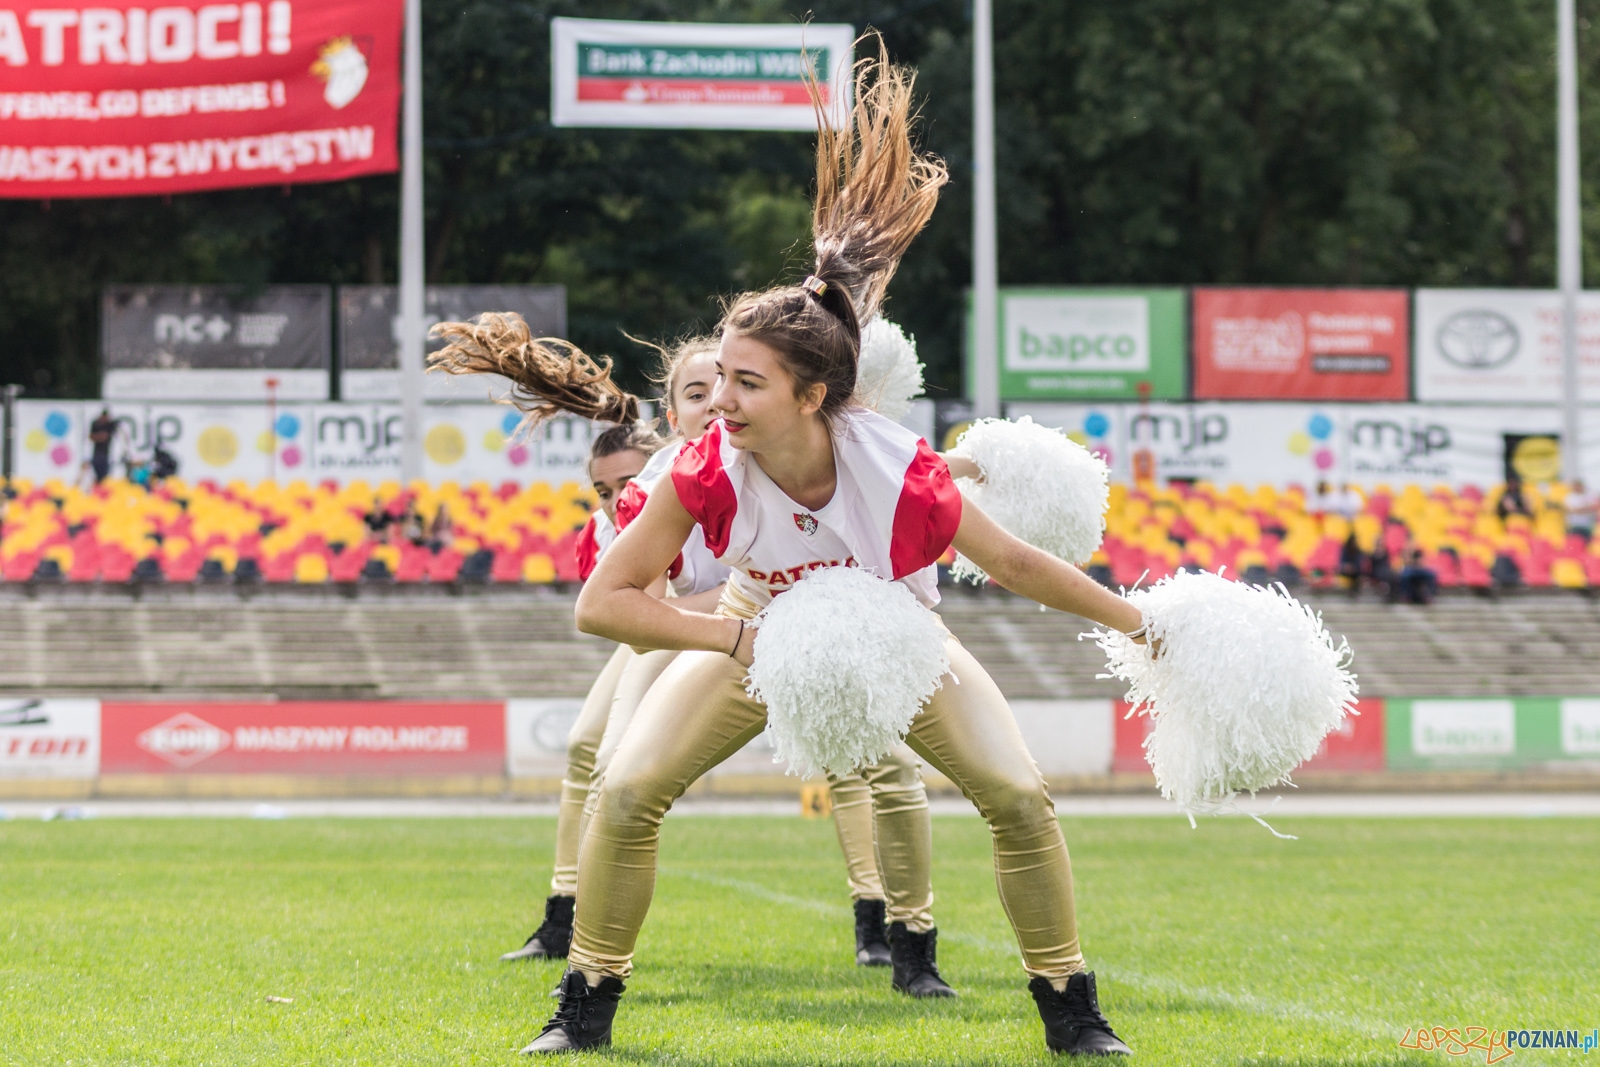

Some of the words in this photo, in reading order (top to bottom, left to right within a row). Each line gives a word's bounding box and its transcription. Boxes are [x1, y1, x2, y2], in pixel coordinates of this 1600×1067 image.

[587, 47, 647, 73] Bank
[650, 49, 756, 75] Zachodni
[141, 82, 270, 117] DEFENSE
[1018, 324, 1137, 363] bapco
[1129, 408, 1230, 453] mjp
[1352, 417, 1451, 459] mjp
[235, 725, 349, 751] MASZYNY
[350, 725, 469, 752] ROLNICZE
